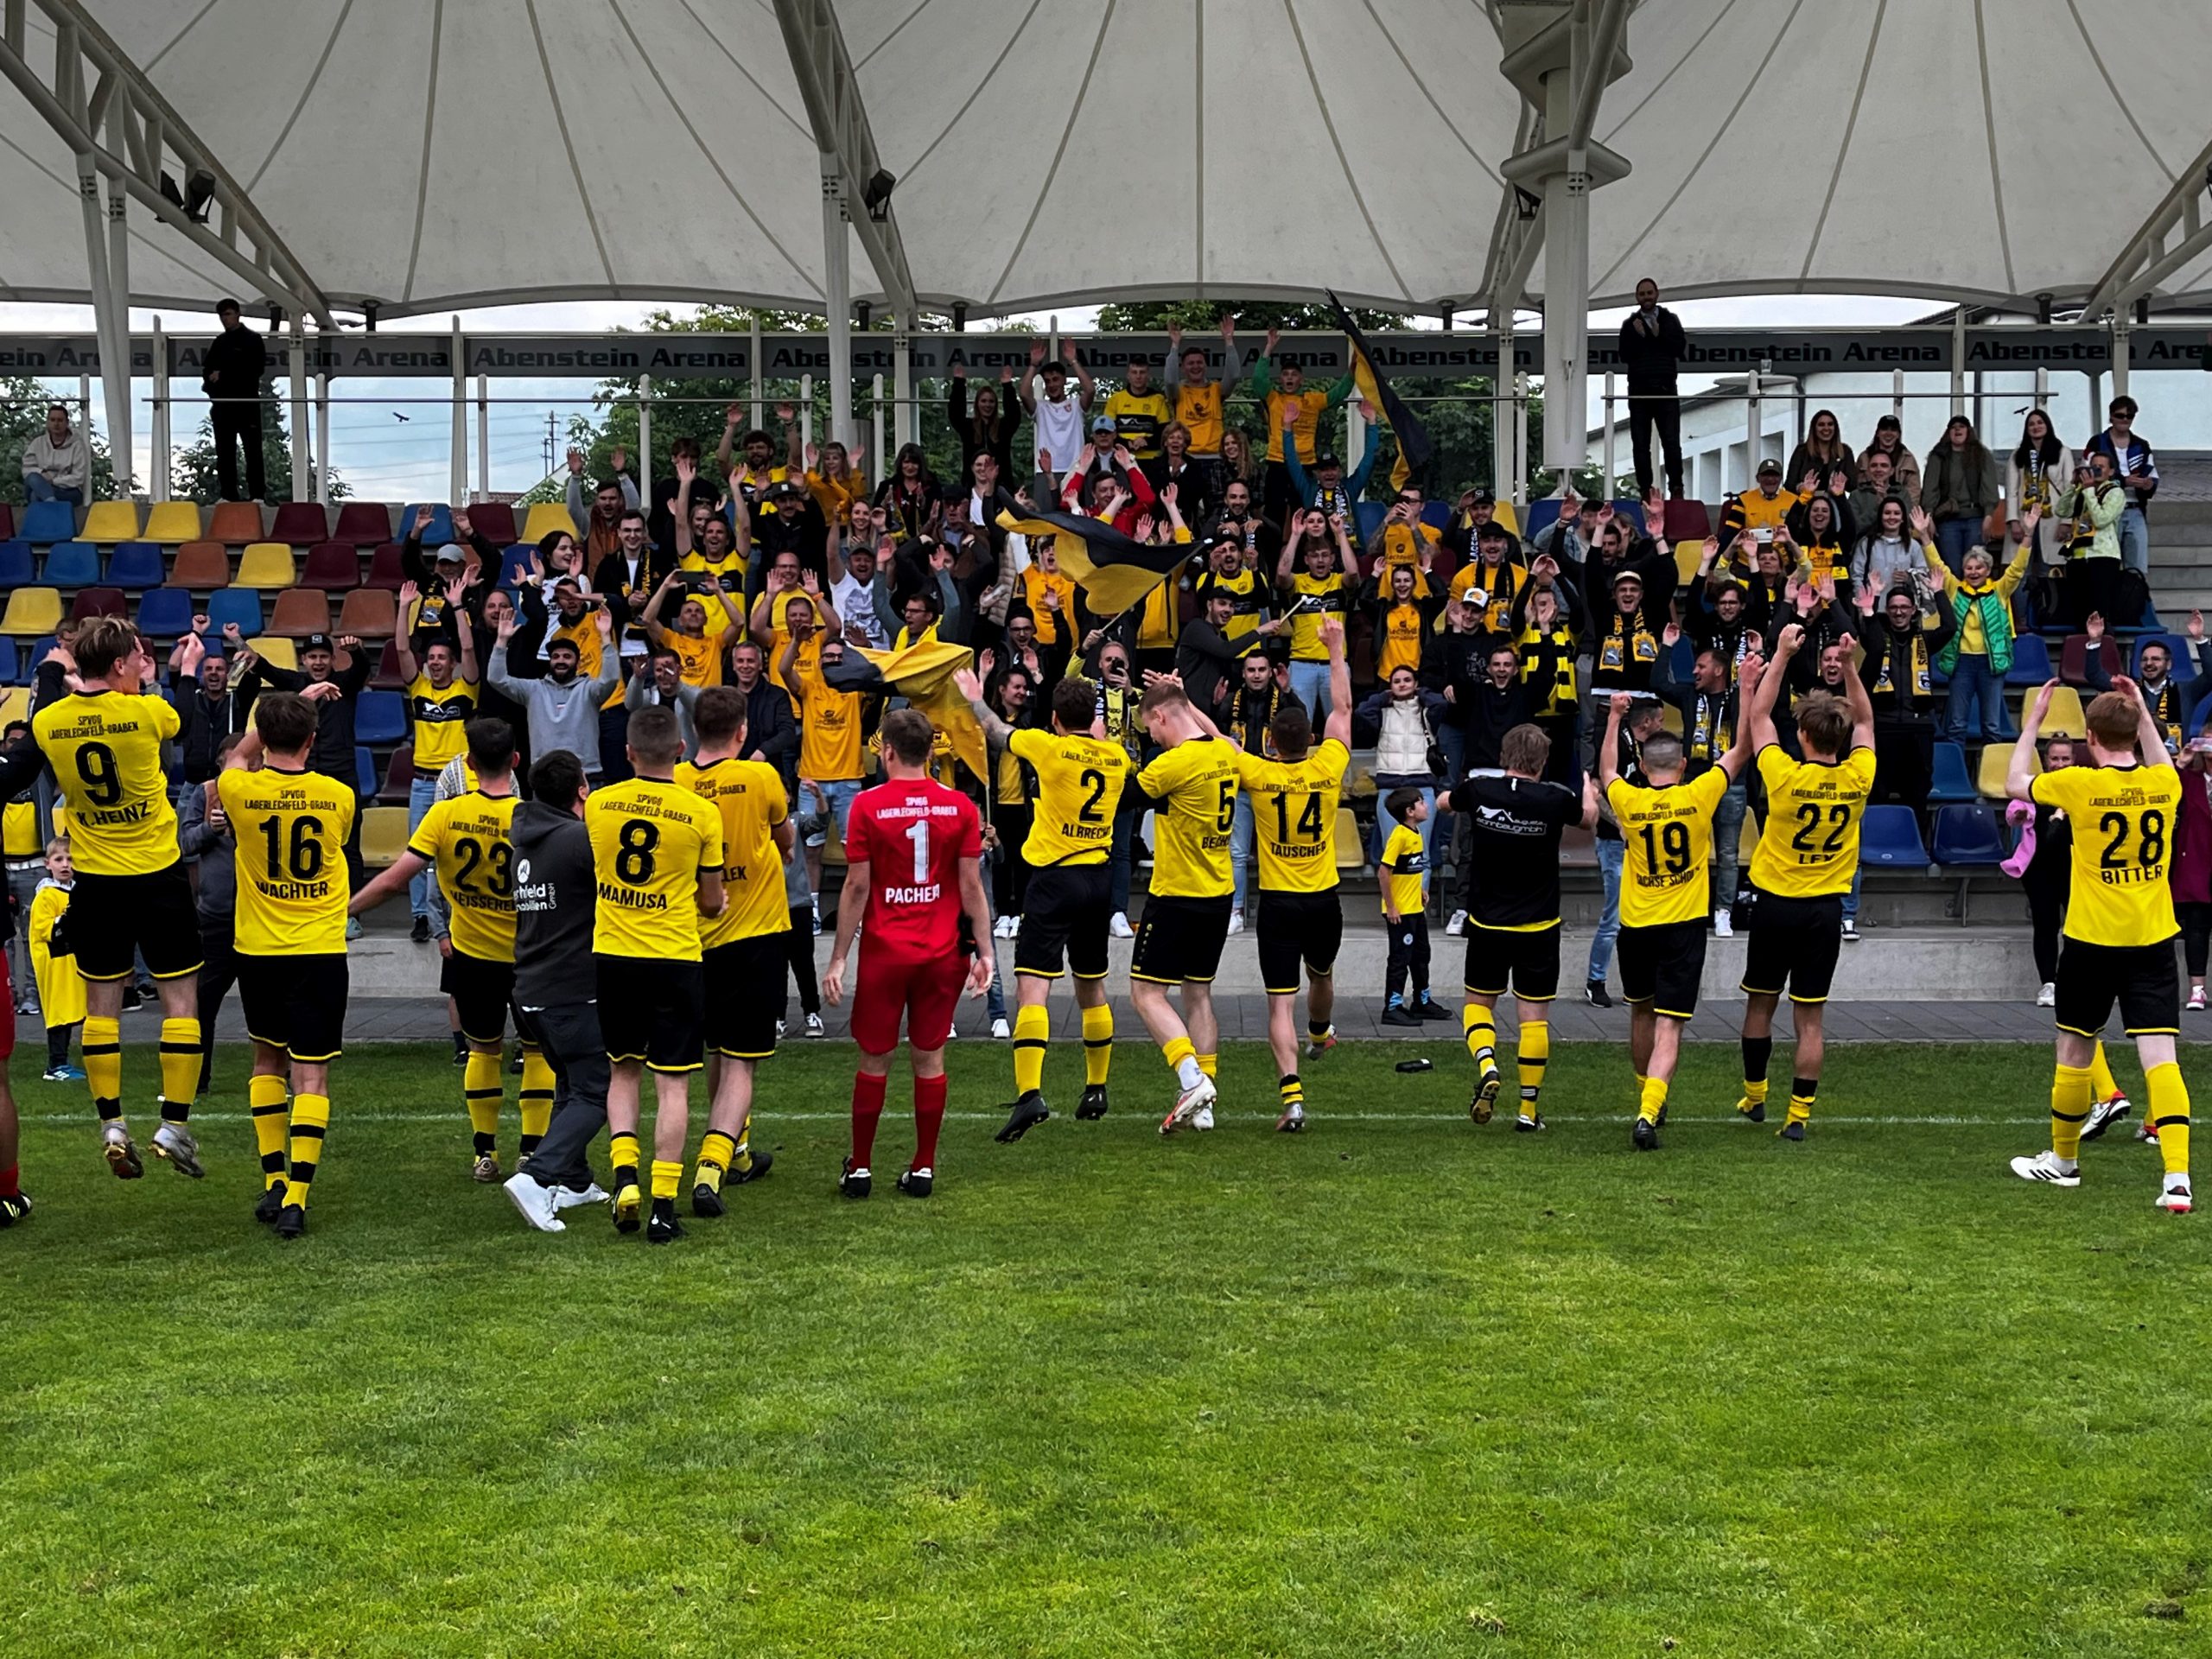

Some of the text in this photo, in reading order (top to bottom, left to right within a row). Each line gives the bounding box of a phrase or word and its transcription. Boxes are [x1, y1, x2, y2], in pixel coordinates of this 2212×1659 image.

[353, 347, 448, 366] Arena
[474, 347, 745, 366] Abenstein Arena
[1842, 343, 1940, 361] Arena
[78, 714, 103, 727] SPVGG
[75, 741, 123, 808] 9
[281, 789, 306, 799] SPVGG
[600, 802, 692, 824] LAGERLECHFELD-GRABEN
[637, 794, 664, 806] SPVGG
[1079, 768, 1107, 823] 2
[1217, 779, 1236, 835] 5
[479, 815, 500, 826] SPVGG
[1271, 791, 1324, 843] 14
[1791, 803, 1851, 852] 22
[258, 814, 324, 880] 16
[615, 818, 661, 887] 8
[906, 819, 929, 883] 1
[1638, 821, 1690, 875] 19
[2100, 809, 2164, 869] 28
[454, 837, 514, 896] 23
[2101, 865, 2163, 885] BITTER
[255, 880, 328, 899] WACHTER
[599, 882, 668, 910] MAMUSA
